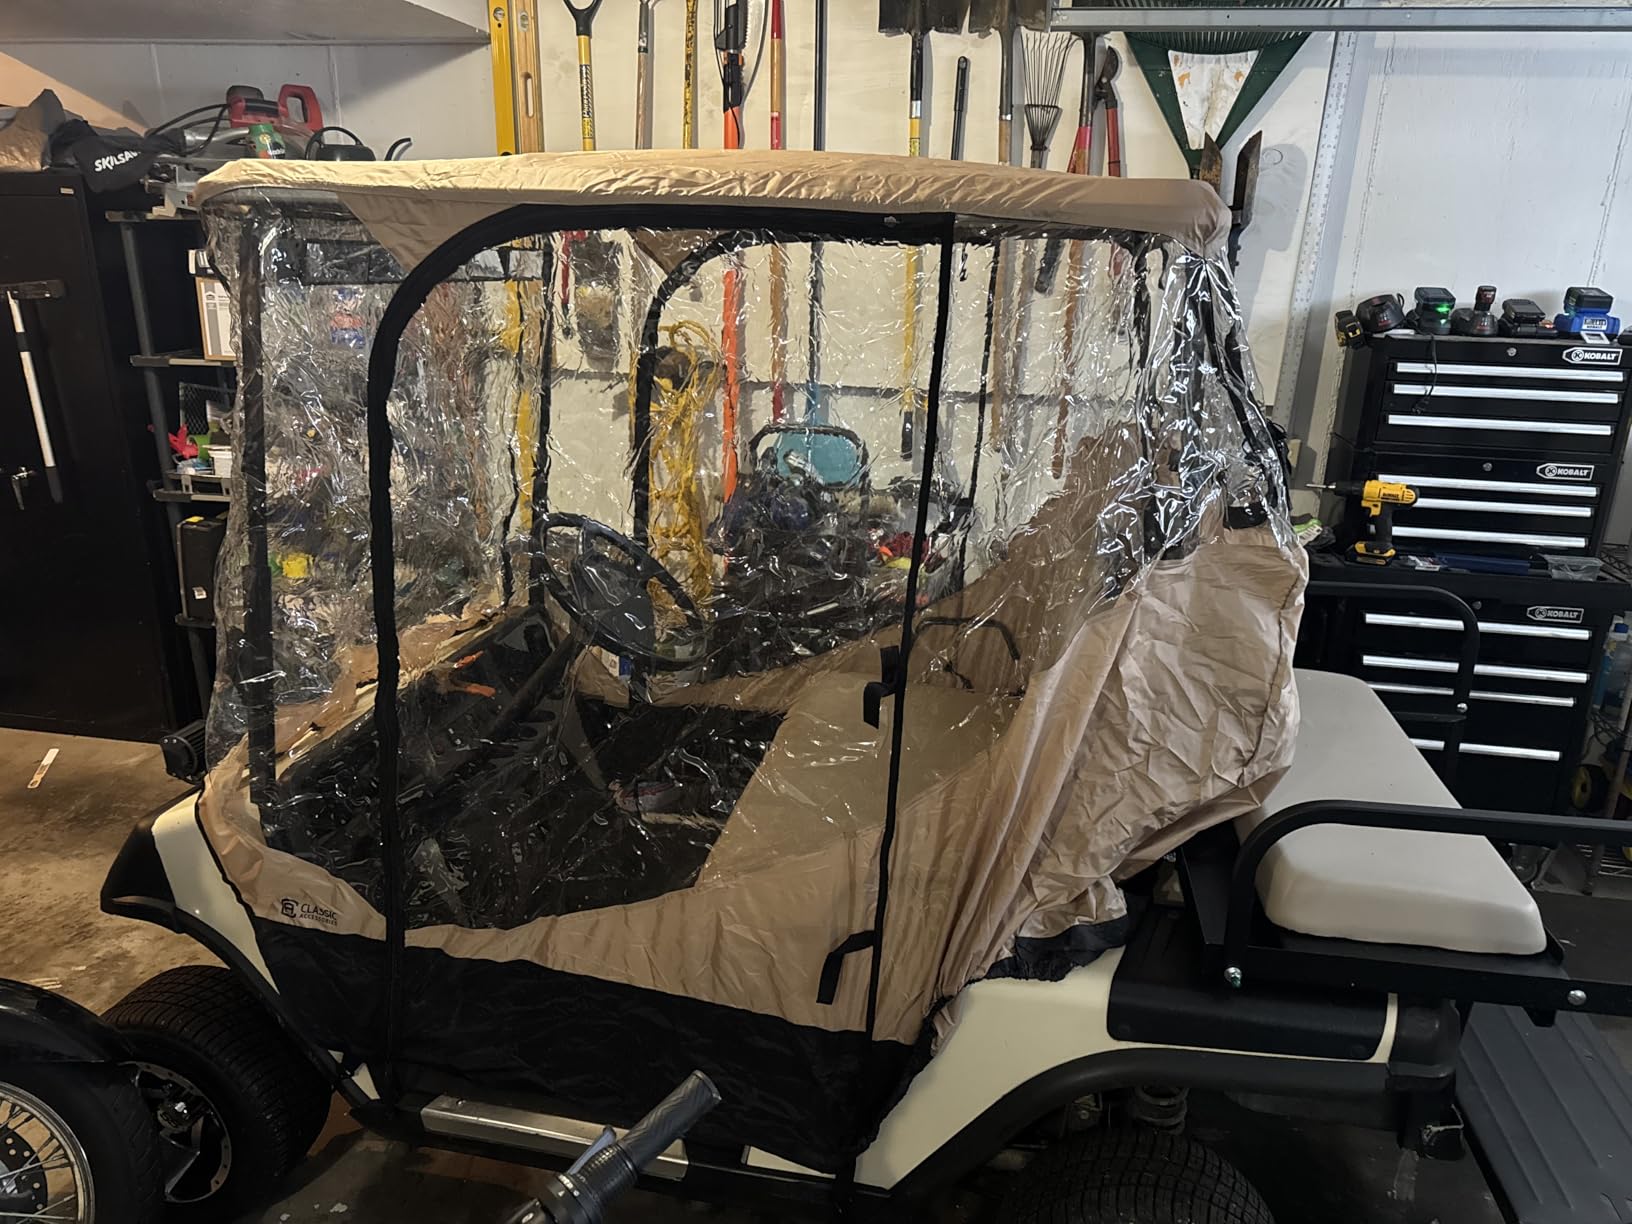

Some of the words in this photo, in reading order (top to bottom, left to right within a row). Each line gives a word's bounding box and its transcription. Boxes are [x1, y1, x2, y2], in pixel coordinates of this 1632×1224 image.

[1584, 352, 1617, 361] KOBALT
[1557, 468, 1589, 476] KOBALT
[1547, 610, 1578, 619] KOBALT
[300, 903, 337, 921] CLASSIC
[299, 913, 338, 926] ACCESSORIES
